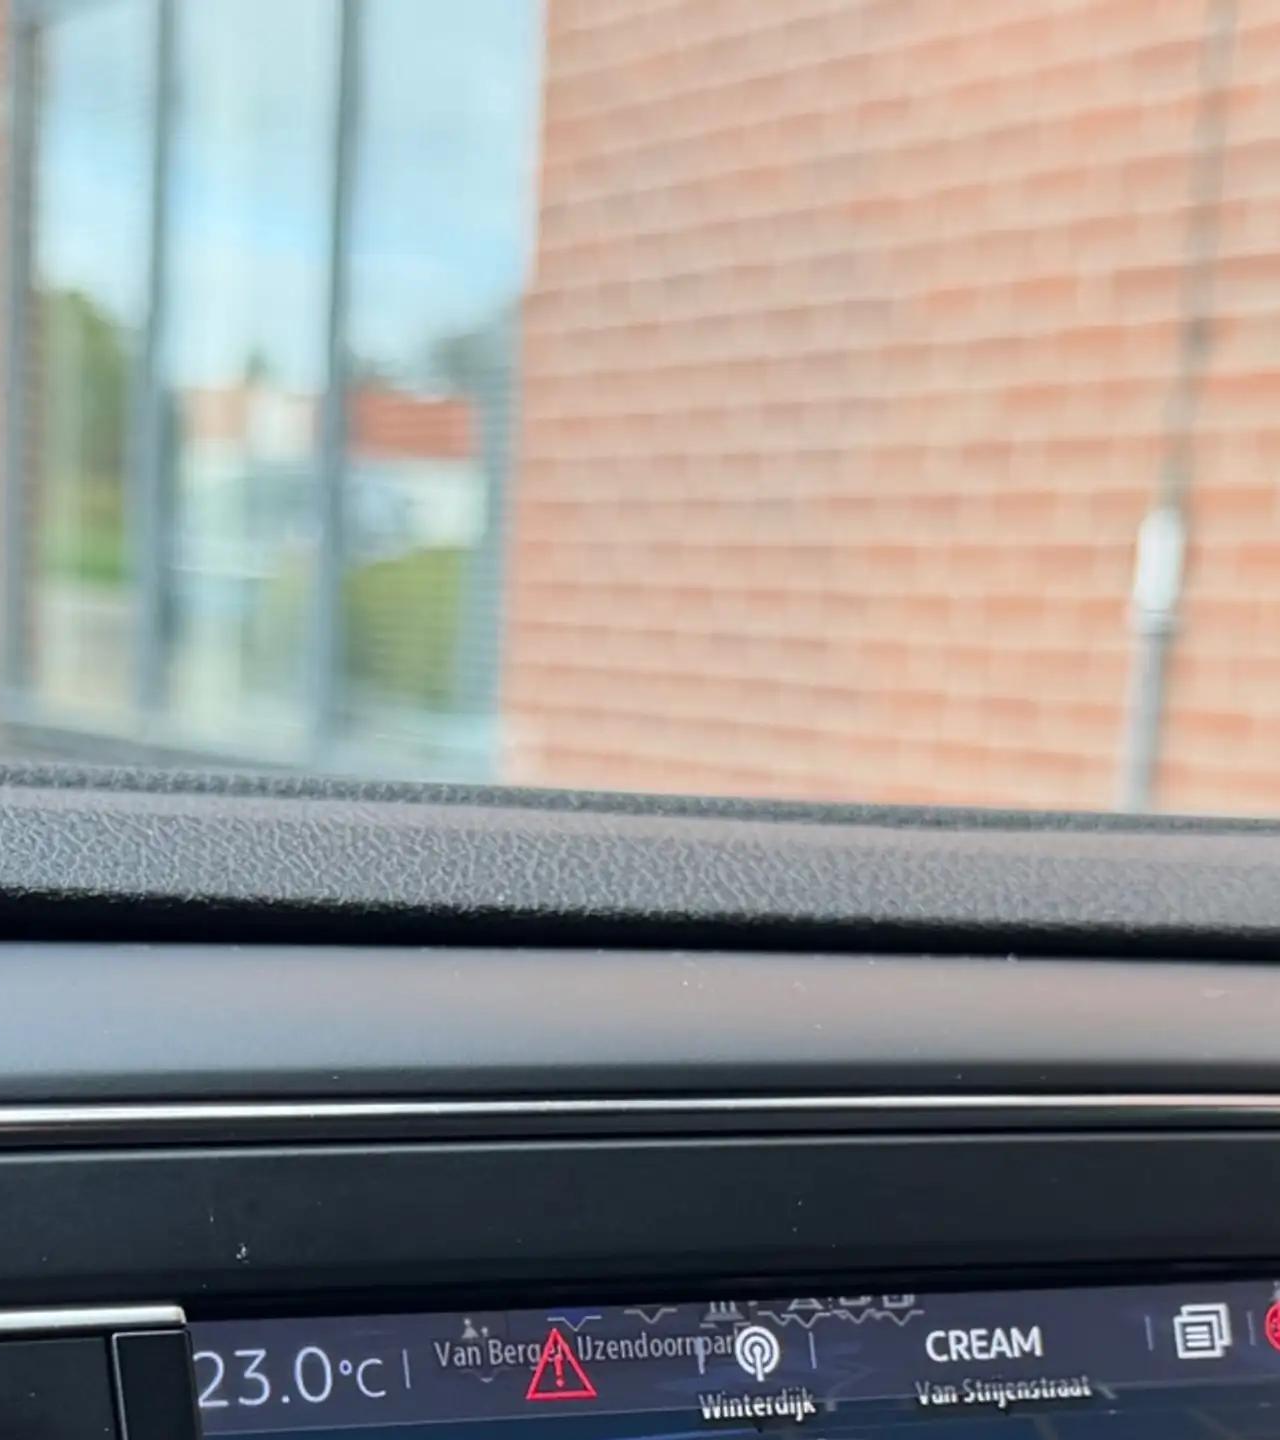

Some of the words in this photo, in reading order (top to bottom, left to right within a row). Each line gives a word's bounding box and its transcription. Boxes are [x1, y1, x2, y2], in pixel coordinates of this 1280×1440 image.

[433, 1339, 483, 1368] Van
[488, 1337, 568, 1372] Berge
[577, 1325, 744, 1363] IJzendoornpar
[925, 1326, 1044, 1363] CREAM
[698, 1390, 817, 1422] Winterdijk
[914, 1379, 959, 1406] Van
